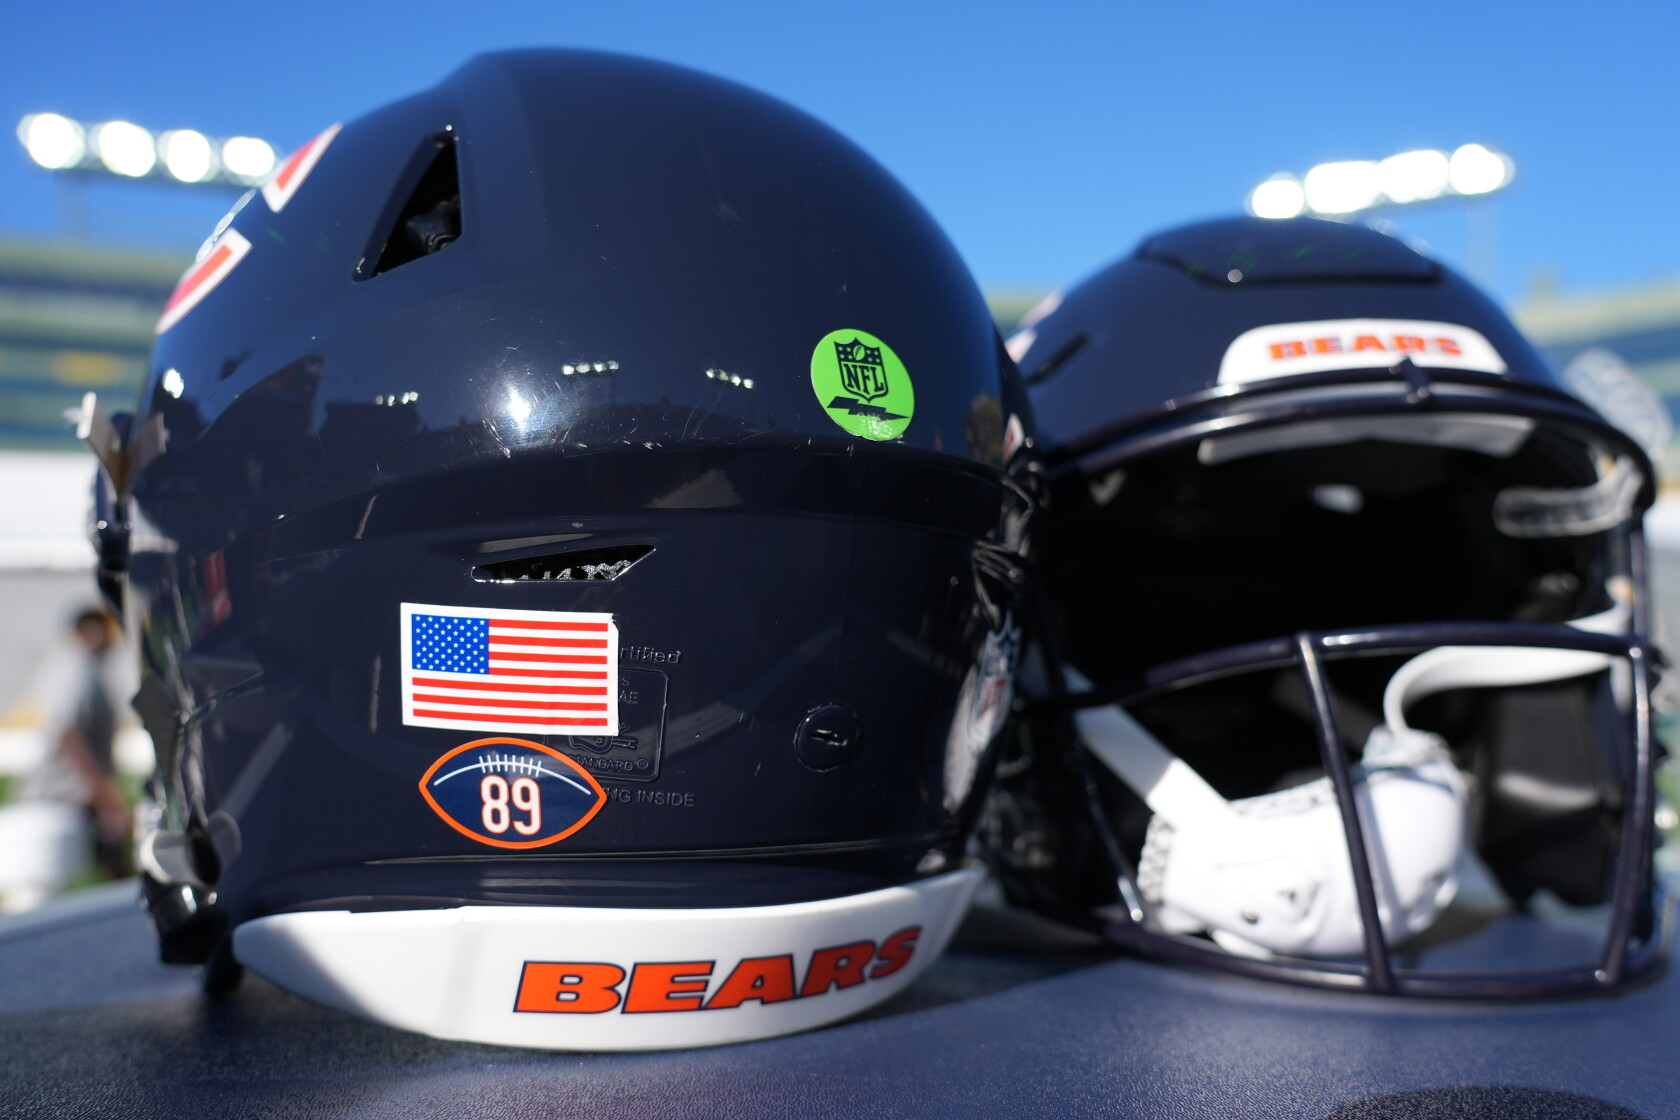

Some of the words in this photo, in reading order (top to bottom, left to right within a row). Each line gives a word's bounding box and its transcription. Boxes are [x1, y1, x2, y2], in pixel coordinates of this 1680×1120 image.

[1268, 335, 1462, 361] BEARS
[843, 363, 885, 395] NFL
[569, 755, 634, 771] TANDARD
[480, 774, 542, 835] 89
[604, 786, 631, 803] NG
[638, 789, 695, 807] INSIDE
[513, 925, 922, 1014] BEARS
